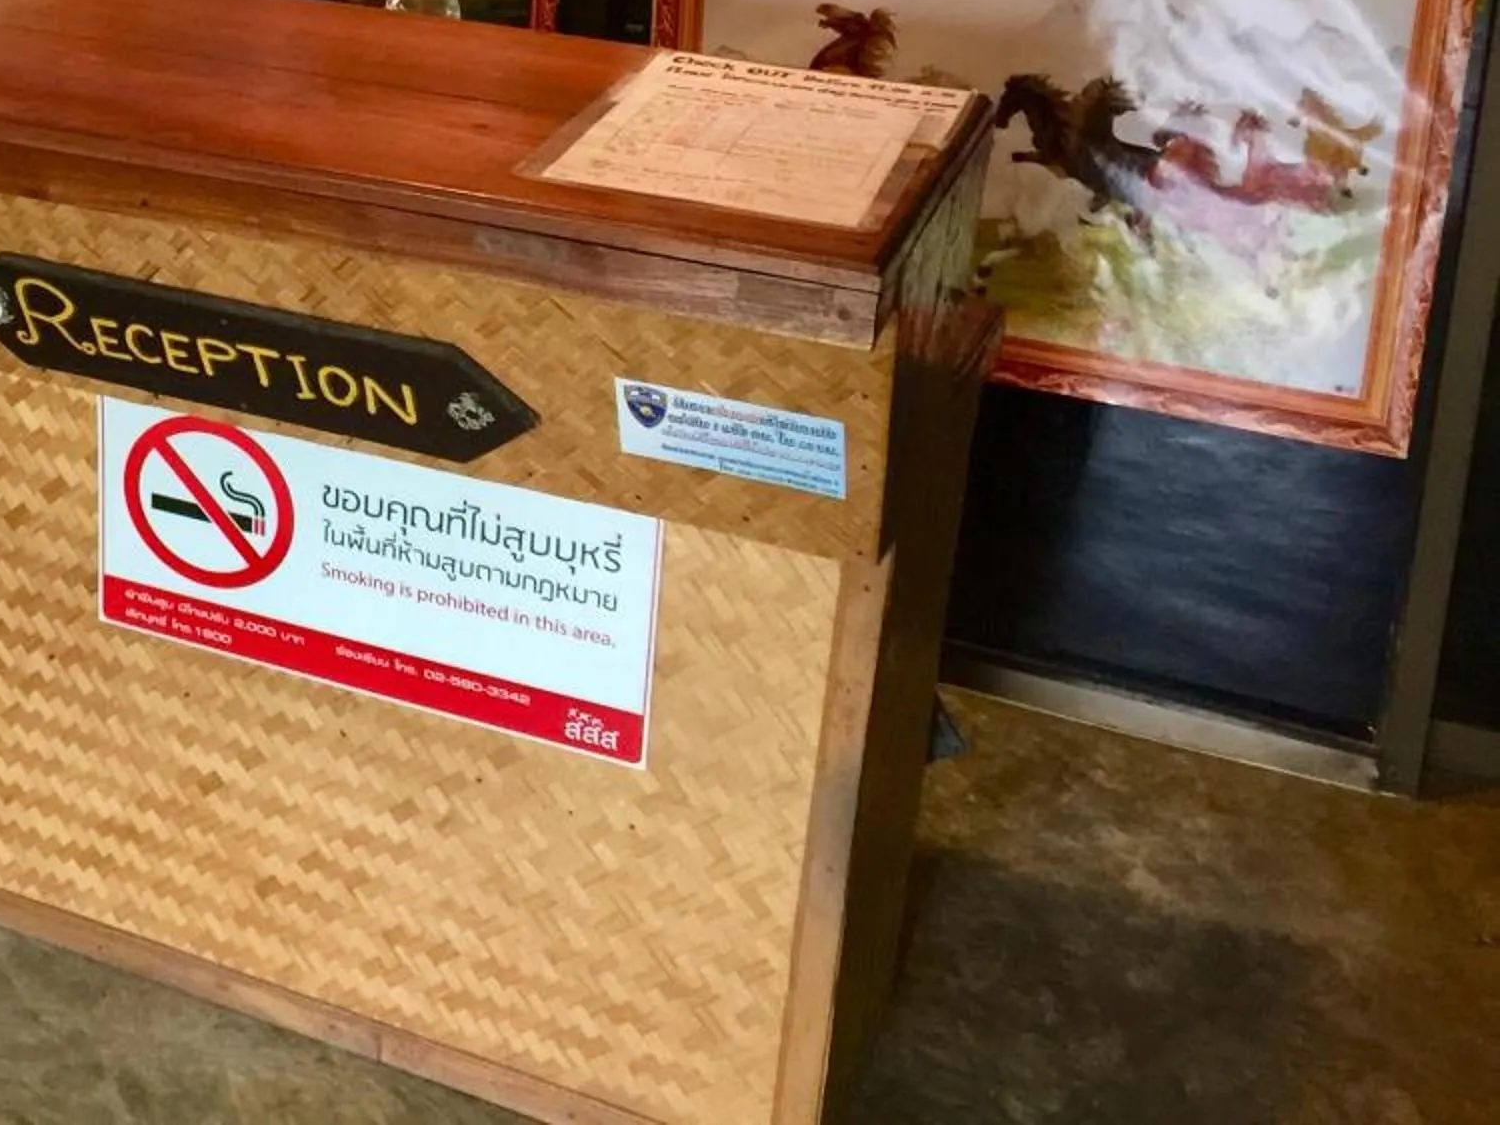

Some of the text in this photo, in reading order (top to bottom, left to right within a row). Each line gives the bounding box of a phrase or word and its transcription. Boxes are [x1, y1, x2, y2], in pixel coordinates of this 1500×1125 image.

[14, 277, 421, 426] RECEPTION
[321, 483, 624, 575] ขอบคุณที่ไม่สูบบุหรี่
[321, 562, 617, 649] Smoking is prohibited in this area.
